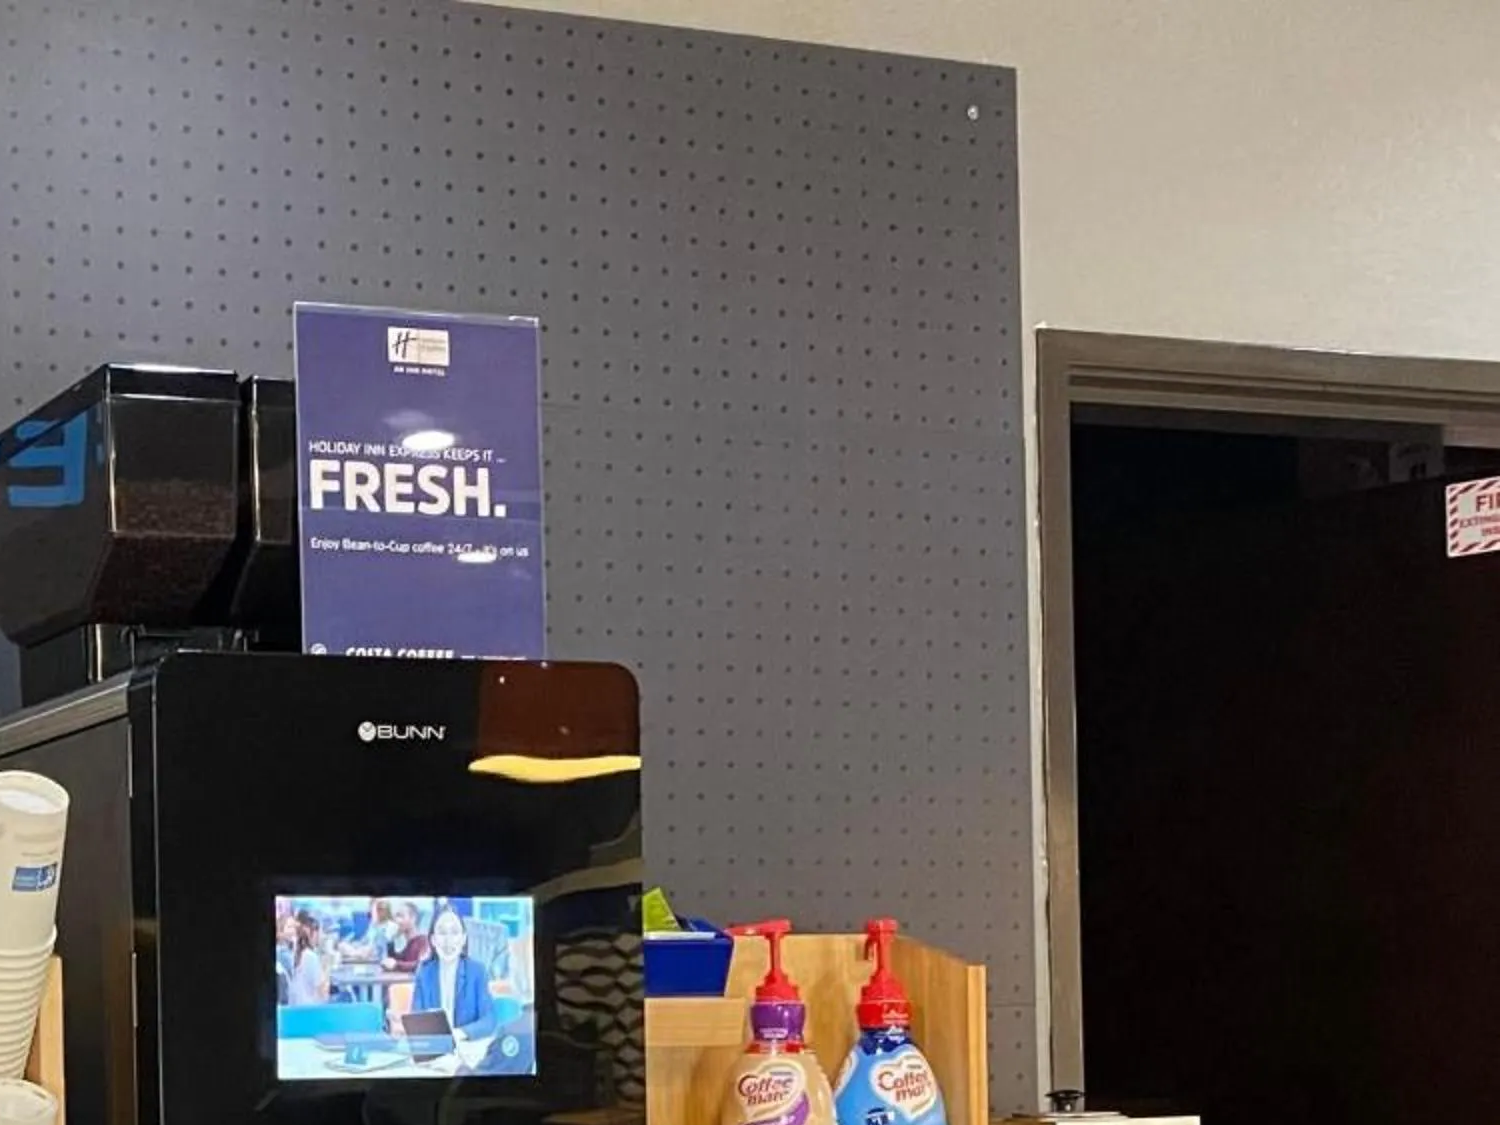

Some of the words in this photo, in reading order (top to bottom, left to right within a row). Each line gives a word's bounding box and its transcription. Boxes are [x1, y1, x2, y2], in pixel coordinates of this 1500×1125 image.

[309, 440, 360, 455] HOLIDAY
[364, 444, 385, 456] INN
[309, 459, 506, 518] FRESH.
[377, 725, 446, 740] BUNN
